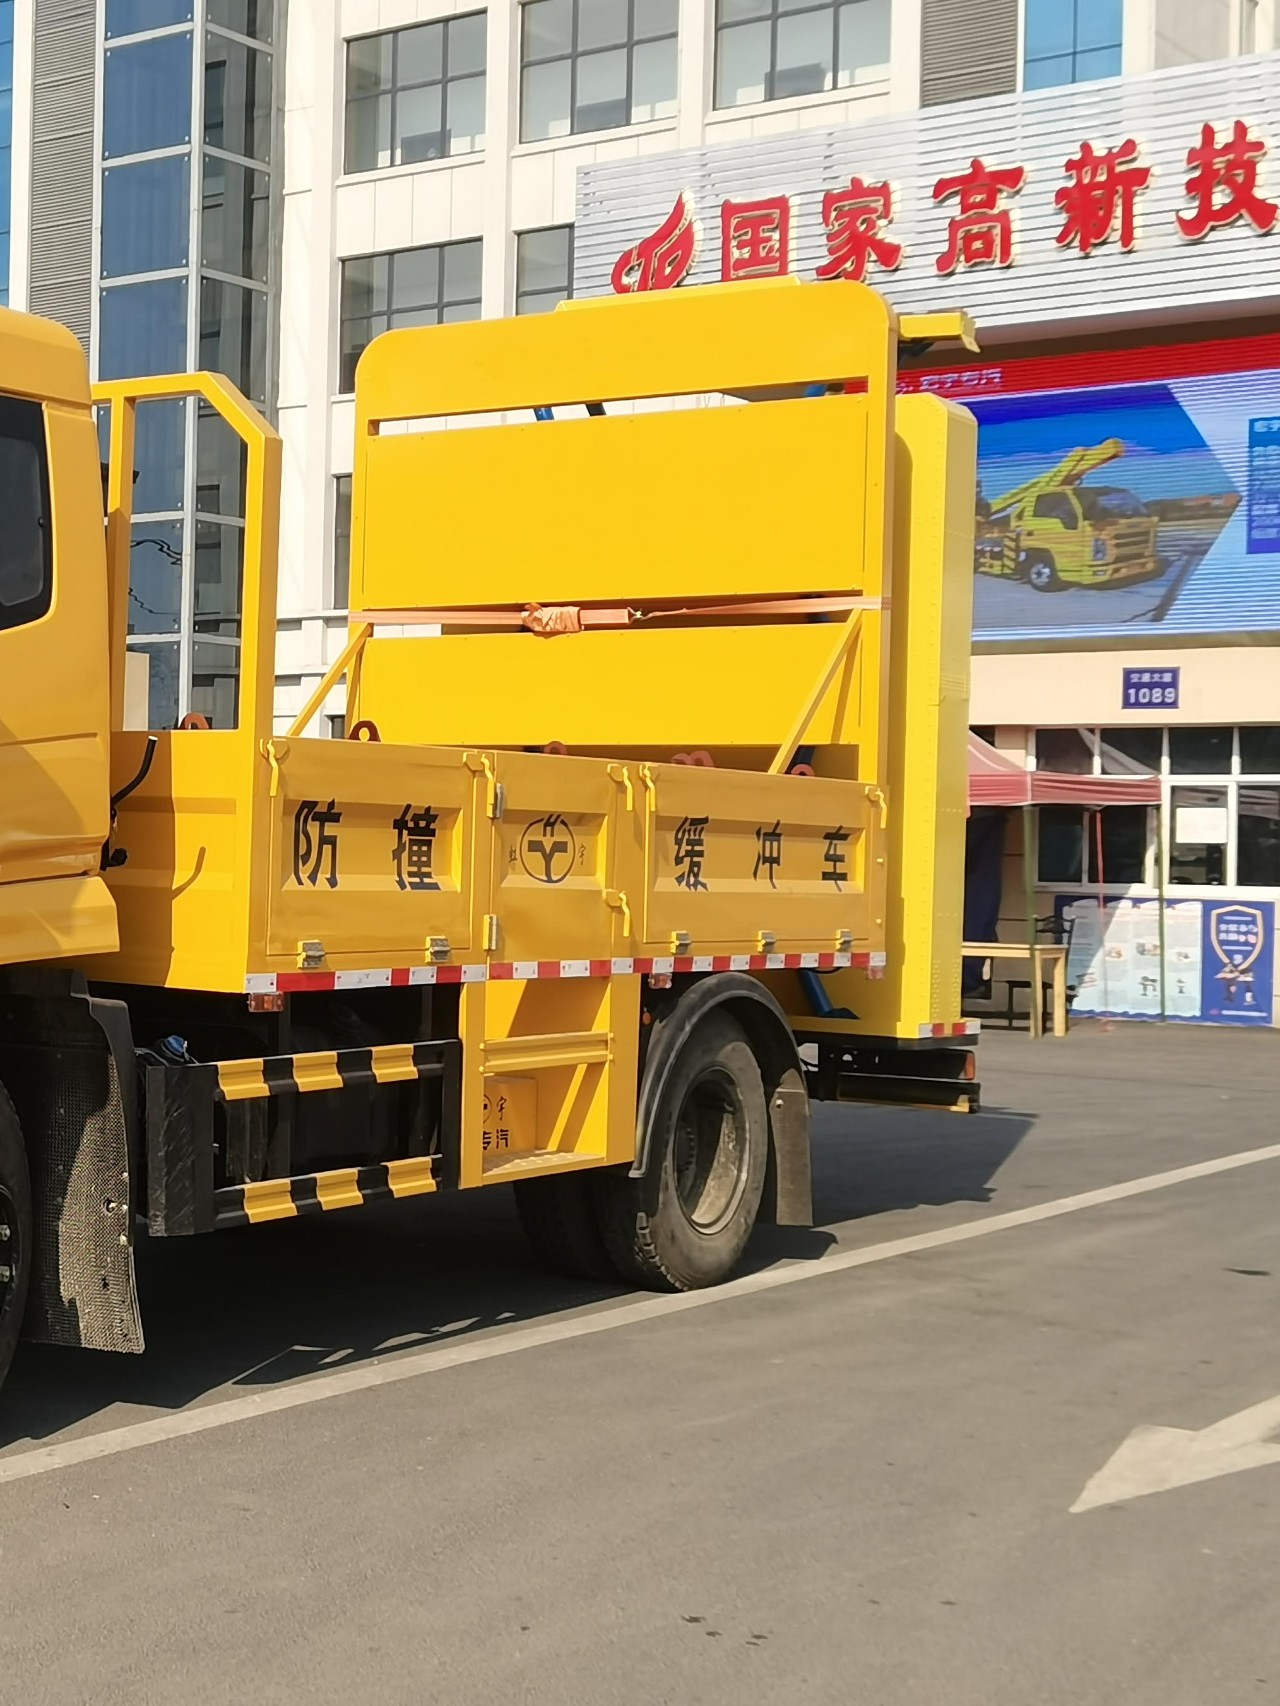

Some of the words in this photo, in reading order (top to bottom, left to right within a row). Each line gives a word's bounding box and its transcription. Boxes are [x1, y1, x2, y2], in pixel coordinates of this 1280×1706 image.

[720, 119, 1279, 282] 国家高新技
[1127, 687, 1176, 704] 1089
[293, 798, 442, 891] 防撞
[673, 816, 850, 892] 缓冲车
